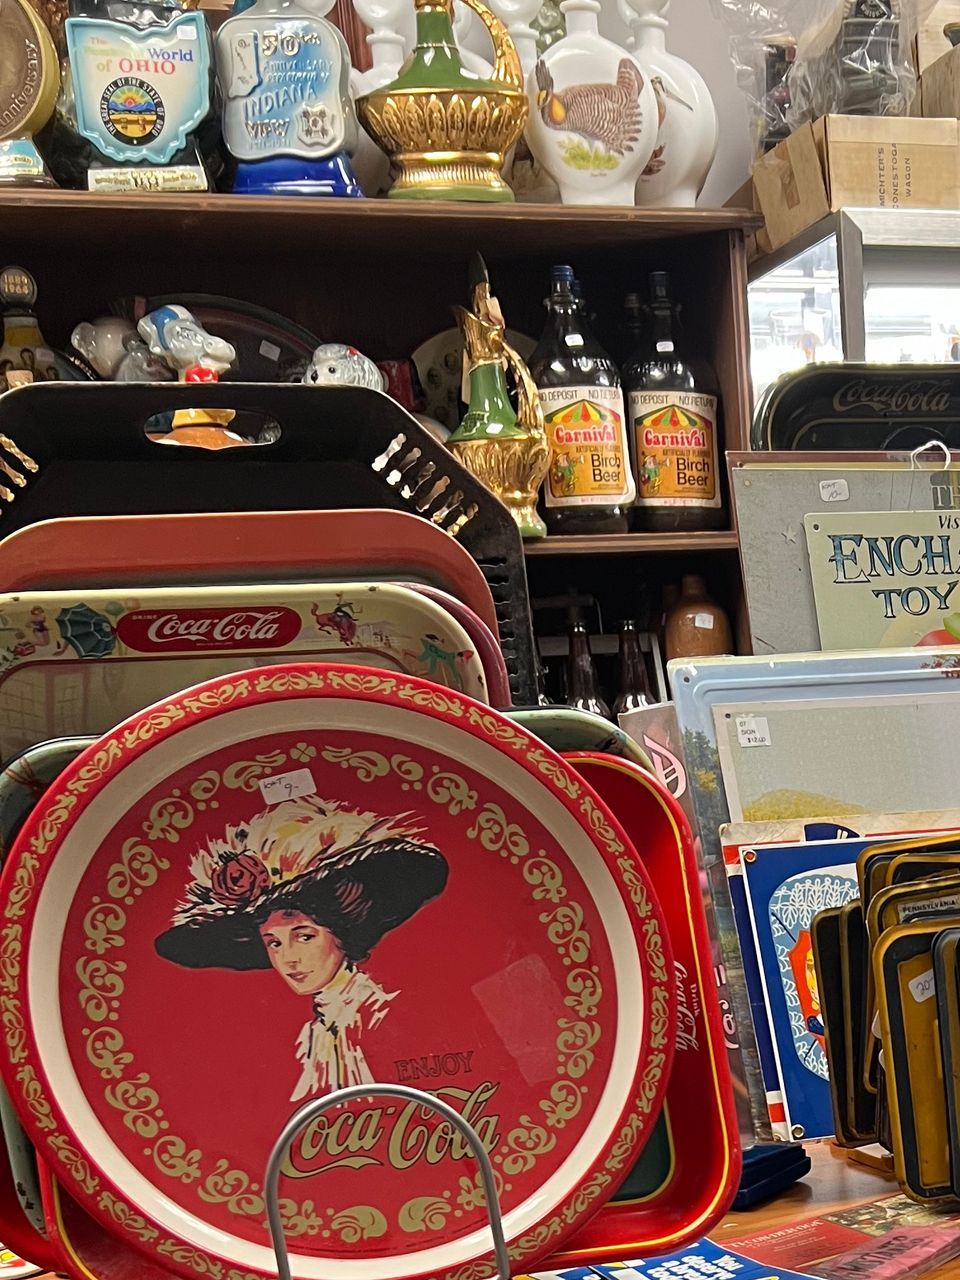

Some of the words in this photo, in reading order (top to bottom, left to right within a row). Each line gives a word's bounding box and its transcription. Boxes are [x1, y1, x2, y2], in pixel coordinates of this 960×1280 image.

[148, 48, 194, 62] World
[97, 60, 112, 72] of
[119, 58, 176, 75] OHIO
[548, 390, 578, 401] DEPOSIT
[588, 390, 599, 398] NO
[640, 394, 669, 405] DEPOSIT
[678, 396, 691, 406] NO
[833, 377, 952, 412] Coca-Cola
[555, 424, 616, 444] Carnival
[644, 428, 707, 448] Carnival
[591, 453, 621, 468] Birch
[676, 457, 710, 472] Birch
[592, 469, 621, 483] Beer
[677, 472, 709, 486] Beer
[872, 579, 960, 619] TOY
[148, 609, 283, 643] Coca-Cola
[902, 897, 958, 913] PENNSYLVANIA
[690, 983, 701, 1017] Drink
[394, 1050, 475, 1082] ENJOY
[280, 1081, 501, 1179] Coca-Cola
[681, 1256, 736, 1280] deserve
[713, 1255, 744, 1271] You
